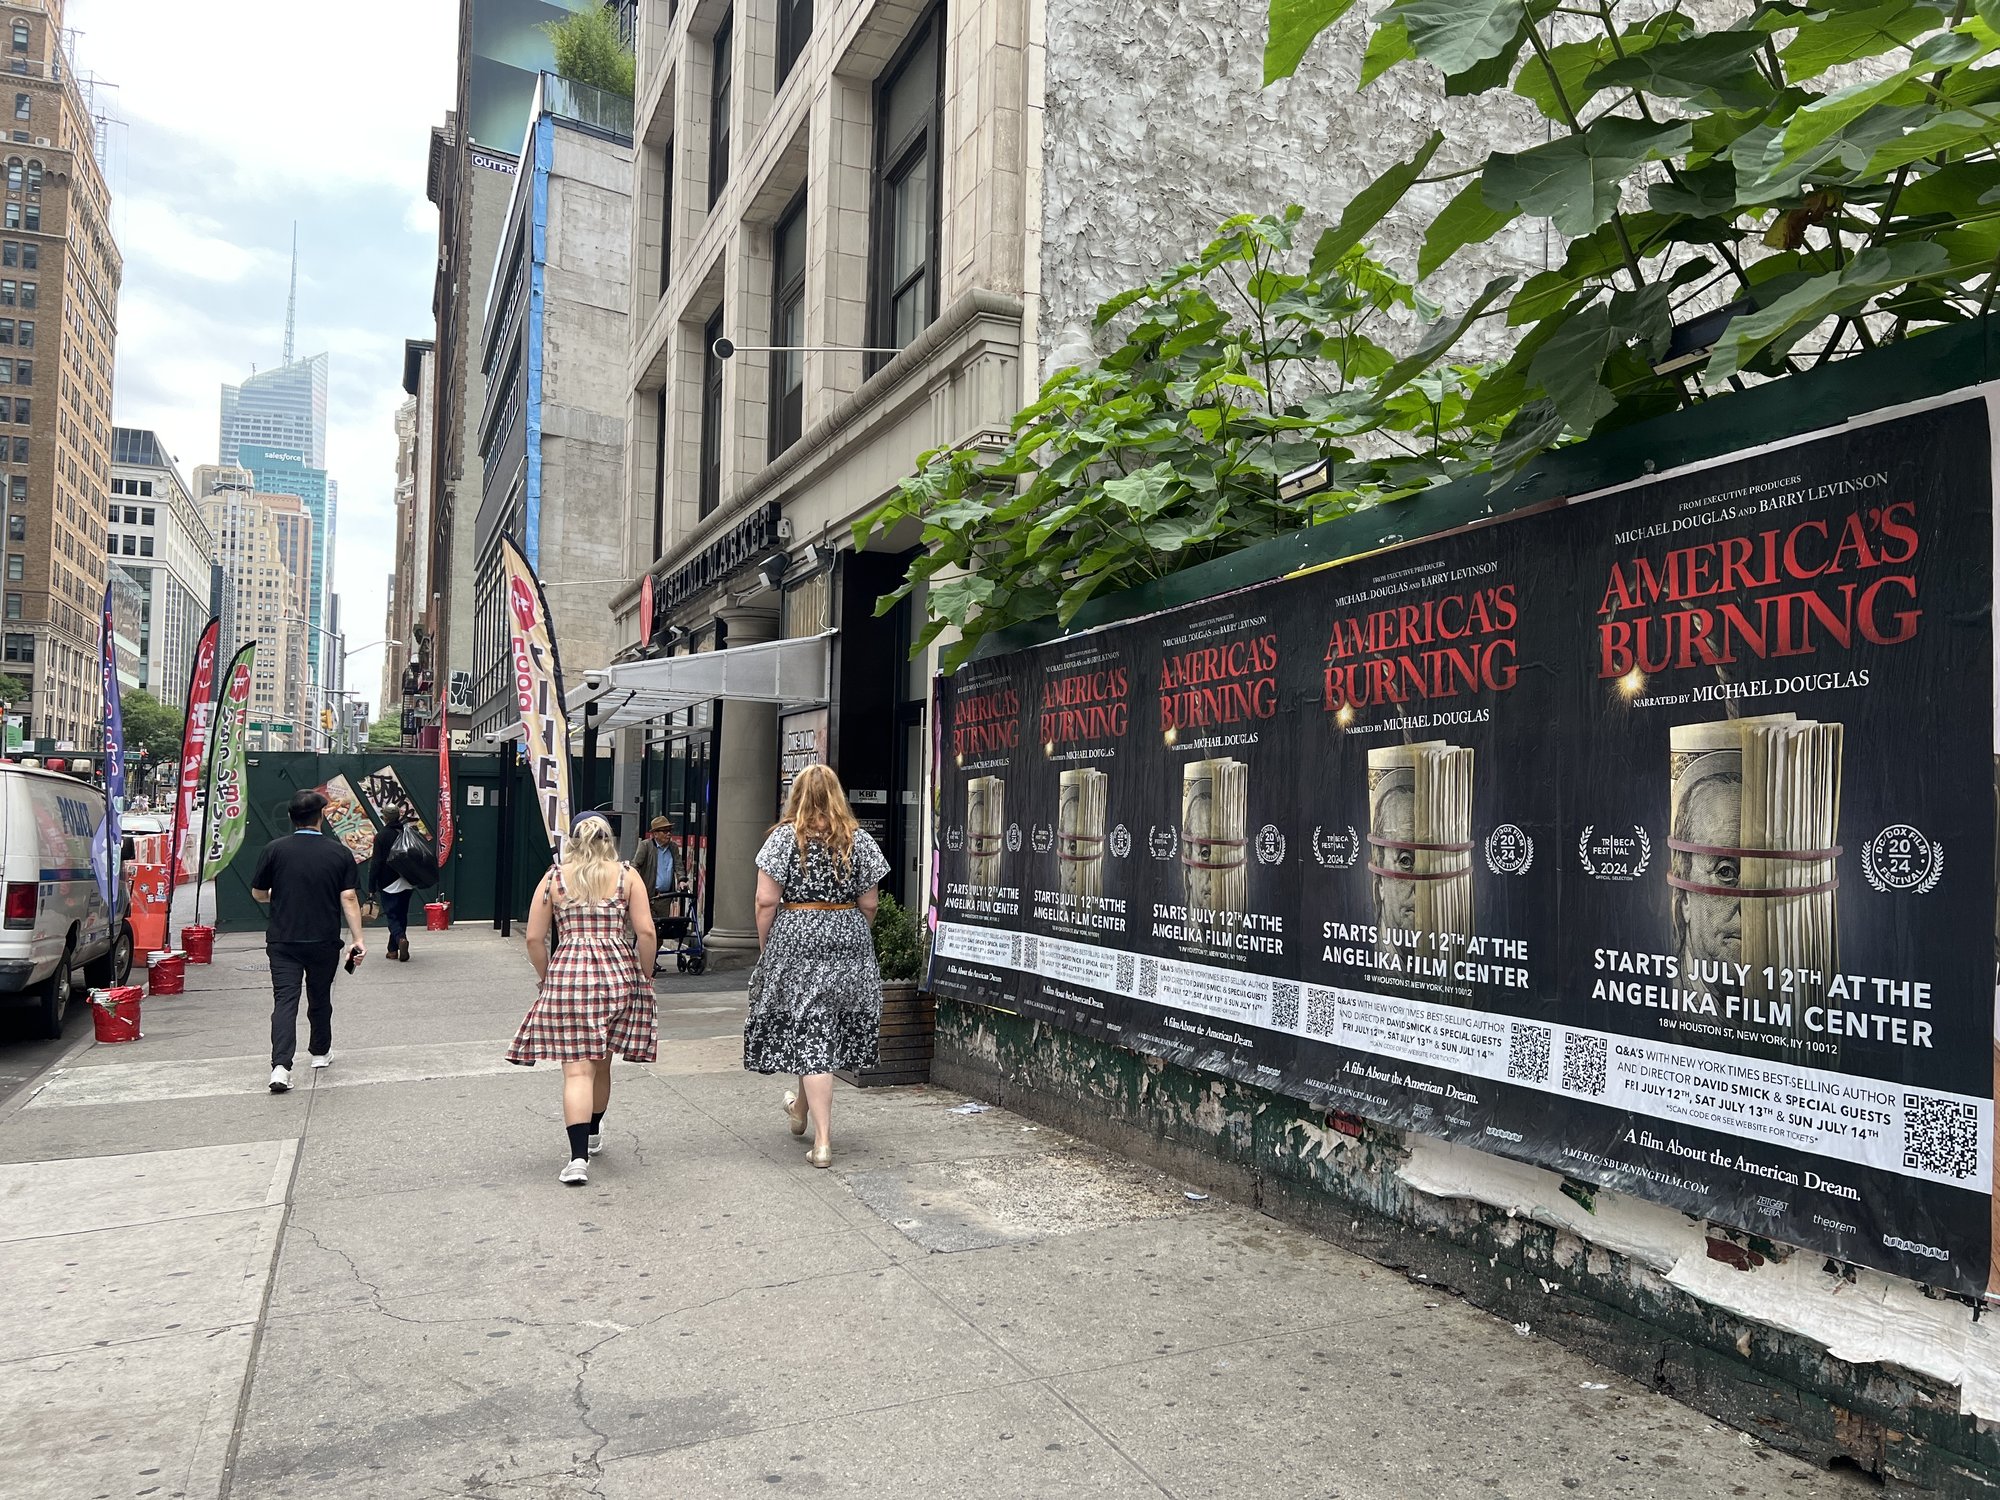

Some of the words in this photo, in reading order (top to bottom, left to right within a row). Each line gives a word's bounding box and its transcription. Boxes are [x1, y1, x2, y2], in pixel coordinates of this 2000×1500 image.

[264, 452, 301, 462] salesforce
[1614, 521, 1669, 544] MICHAEL
[1672, 506, 1735, 532] DOUGLAS
[1739, 505, 1756, 517] AND
[1759, 490, 1804, 512] BARRY
[1808, 471, 1888, 502] LEVINSON
[1679, 499, 1701, 511] FROM
[1703, 488, 1747, 505] EXECUTIVE
[1749, 475, 1800, 495] PRODUCERS
[654, 554, 702, 616] FUSHIMI
[704, 502, 773, 585] MARKET
[1597, 498, 1918, 614] AMERICA'S
[1370, 581, 1407, 599] DOUGLAS
[1451, 561, 1497, 581] LEVINSON
[1324, 582, 1516, 661] AMERICA'S
[1598, 570, 1922, 678] BURNING
[1158, 632, 1276, 690] AMERICA'S
[1323, 636, 1519, 711] BURNING
[1040, 665, 1128, 709] AMERICA'S
[1159, 676, 1276, 732] BURNING
[1633, 694, 1677, 708] NARRATED
[1679, 693, 1690, 704] BY
[1693, 679, 1772, 702] MICHAEL
[1776, 669, 1869, 694] DOUGLAS
[1039, 701, 1128, 745] BURNING
[1384, 714, 1430, 731] MICHAEL
[1433, 708, 1489, 726] DOUGLAS
[1193, 736, 1223, 749] MICHAEL
[1224, 732, 1258, 746] DOUGLAS
[56, 796, 94, 838] POLICE
[1500, 835, 1514, 845] 20
[1501, 850, 1514, 859] 24
[1876, 828, 1907, 854] DC/DOX
[1908, 832, 1928, 855] FILM
[1889, 839, 1910, 853] 20
[1327, 854, 1343, 863] 2024
[1600, 862, 1628, 875] 2024
[1880, 866, 1924, 884] FESTIVAL
[1890, 859, 1910, 873] 24
[944, 897, 975, 910] ANGELIKA
[976, 900, 990, 912] FILM
[992, 901, 1018, 914] CENTER
[947, 883, 968, 894] STARTS
[997, 886, 1006, 898] AT
[1006, 887, 1018, 899] THE
[1034, 890, 1059, 904] STARTS
[1059, 892, 1077, 906] JULY
[1100, 897, 1110, 911] AT
[1111, 899, 1126, 913] THE
[1033, 906, 1068, 923] ANGELIKA
[1091, 914, 1125, 931] CENTER
[1153, 904, 1186, 921] STARTS
[1191, 907, 1217, 924] JULY
[1219, 910, 1242, 927] 12TH
[1242, 912, 1260, 930] AT
[1260, 914, 1282, 932] THE
[1152, 923, 1202, 943] ANGELIKA
[1205, 929, 1231, 947] FILM
[1235, 933, 1282, 954] CENTER
[1322, 921, 1377, 943] STARTS
[1382, 927, 1421, 948] JULY
[1429, 931, 1464, 952] 12TH
[1467, 934, 1487, 955] AT
[1491, 938, 1528, 960] THE
[1322, 945, 1401, 972] ANGELIKA
[1406, 954, 1446, 978] FILM
[1454, 960, 1528, 989] CENTER
[1594, 948, 1678, 979] STARTS
[1688, 957, 1751, 988] JULY
[1762, 965, 1821, 996] 12TH
[1828, 971, 1868, 1001] AT
[1871, 976, 1931, 1009] THE
[1592, 978, 1717, 1018] ANGELIKA
[1726, 995, 1790, 1028] FILM
[1805, 1004, 1932, 1048] CENTER
[1386, 1017, 1405, 1029] DAVID
[1406, 1020, 1430, 1034] SMICK
[1433, 1025, 1438, 1035] &
[1440, 1026, 1469, 1041] SPECIAL
[1471, 1031, 1501, 1046] GUESTS
[1679, 1020, 1721, 1038] HOUSTON
[1723, 1027, 1734, 1040] ST,
[1736, 1029, 1758, 1043] NEW
[1760, 1032, 1789, 1048] YORK,
[1806, 1039, 1837, 1055] 10012
[1343, 1060, 1350, 1075] A
[1365, 1065, 1389, 1084] About
[1391, 1070, 1402, 1087] the
[1404, 1073, 1442, 1096] American
[1445, 1082, 1478, 1105] Dream.
[1615, 1045, 1643, 1060] Q&A'S
[1646, 1050, 1669, 1065] WITH
[1671, 1055, 1695, 1070] NEW
[1698, 1059, 1725, 1075] YORK
[1728, 1064, 1760, 1081] TIMES
[1763, 1071, 1839, 1097] BEST-SELLING
[1843, 1086, 1895, 1107] AUTHOR
[1617, 1061, 1637, 1076] AND
[1640, 1066, 1690, 1086] DIRECTOR
[1694, 1075, 1728, 1093] DAVID
[1731, 1082, 1769, 1101] SMICK
[1773, 1090, 1782, 1103] &
[1786, 1092, 1836, 1114] SPECIAL
[1840, 1102, 1890, 1124] GUESTS
[1625, 1079, 1638, 1092] FRI
[1642, 1082, 1666, 1097] JULY
[1668, 1088, 1692, 1104] 12TH,
[1695, 1093, 1715, 1108] SAT
[1718, 1097, 1744, 1114] JULY
[1748, 1103, 1772, 1119] 13TH
[1777, 1109, 1784, 1122] &
[1788, 1111, 1812, 1128] SUN
[1816, 1118, 1847, 1136] JULY
[1851, 1125, 1878, 1143] 14TH
[1689, 1109, 1708, 1120] CODE
[1710, 1113, 1721, 1123] OR
[1722, 1116, 1734, 1126] SEE
[1736, 1119, 1767, 1133] WEBSITE
[1769, 1126, 1784, 1137] FOR
[1623, 1127, 1636, 1146] A
[1639, 1131, 1663, 1153] film
[1666, 1137, 1706, 1163] About
[1710, 1147, 1731, 1170] the
[1736, 1153, 1798, 1186] American
[1804, 1169, 1860, 1202] Dream.
[1813, 1214, 1857, 1234] theorem
[1883, 1234, 1949, 1261] ABRAMORAMA
